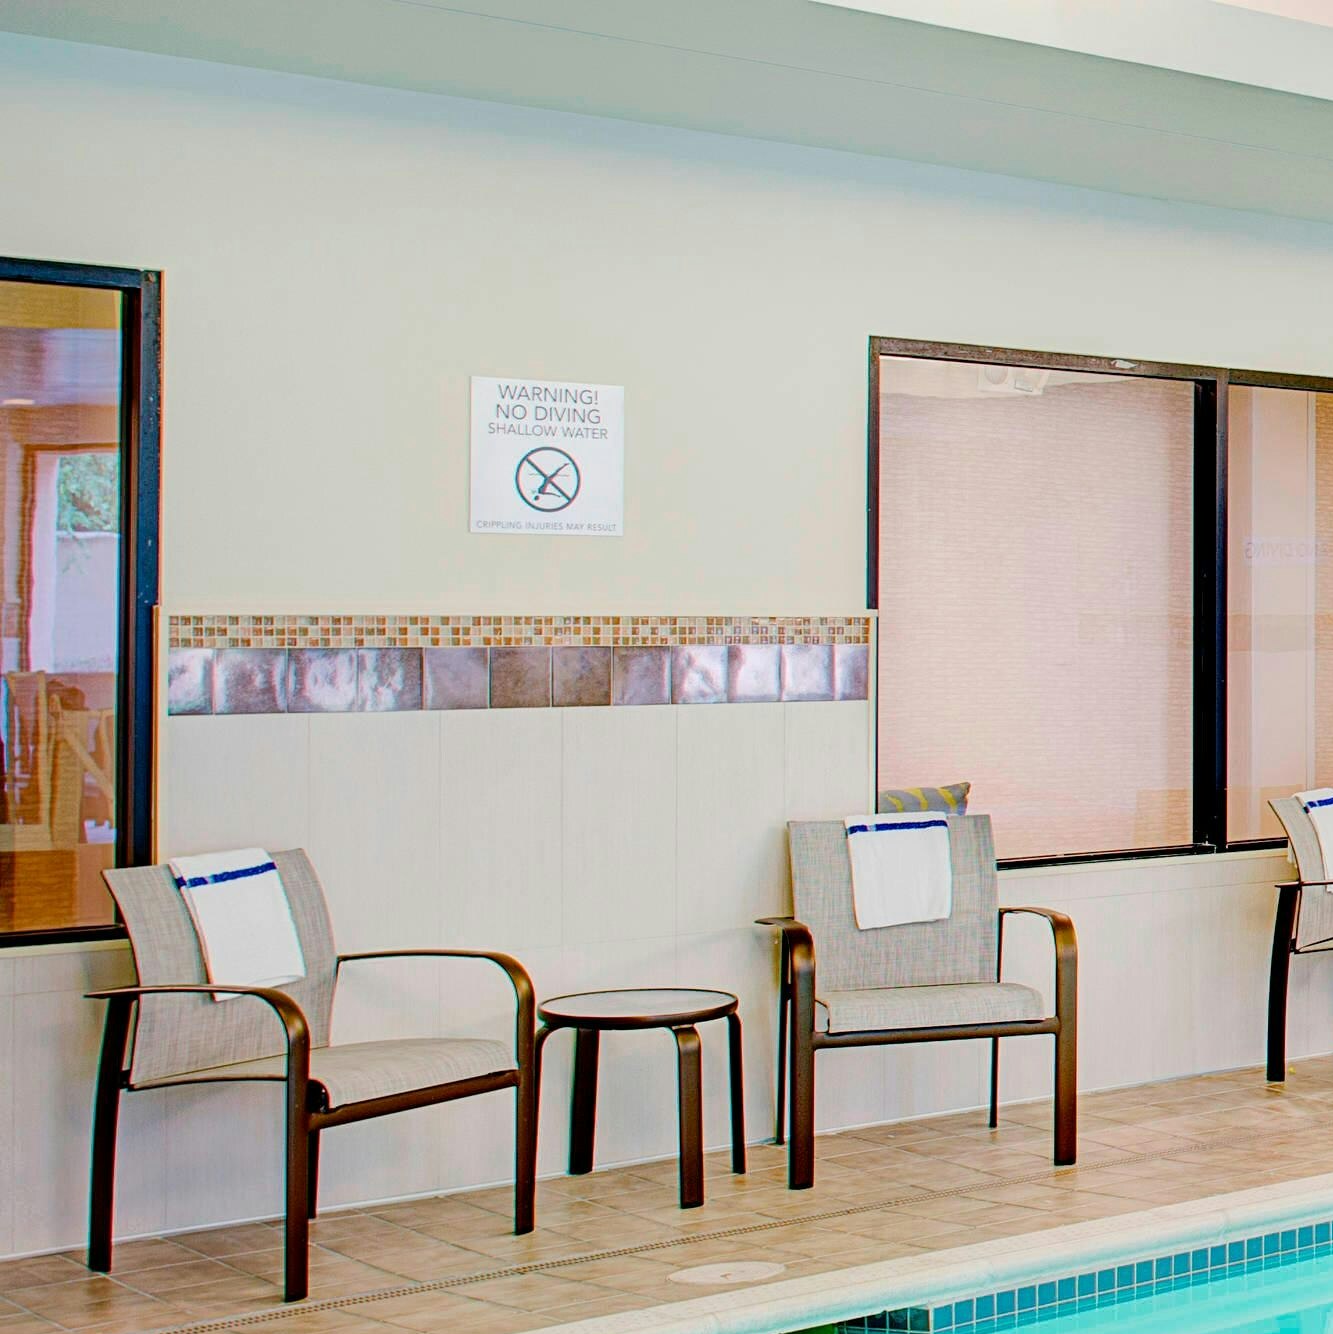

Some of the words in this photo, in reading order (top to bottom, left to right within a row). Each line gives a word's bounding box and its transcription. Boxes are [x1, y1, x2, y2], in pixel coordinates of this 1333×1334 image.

[498, 384, 598, 405] WARNING!
[496, 404, 527, 421] NO
[535, 406, 601, 425] DIVING
[488, 422, 558, 438] SHALLOW
[562, 427, 608, 440] WATER
[476, 520, 522, 529] CRIPPLING
[525, 521, 563, 531] INJURIES
[566, 523, 584, 531] MAY
[588, 523, 617, 532] RESULT
